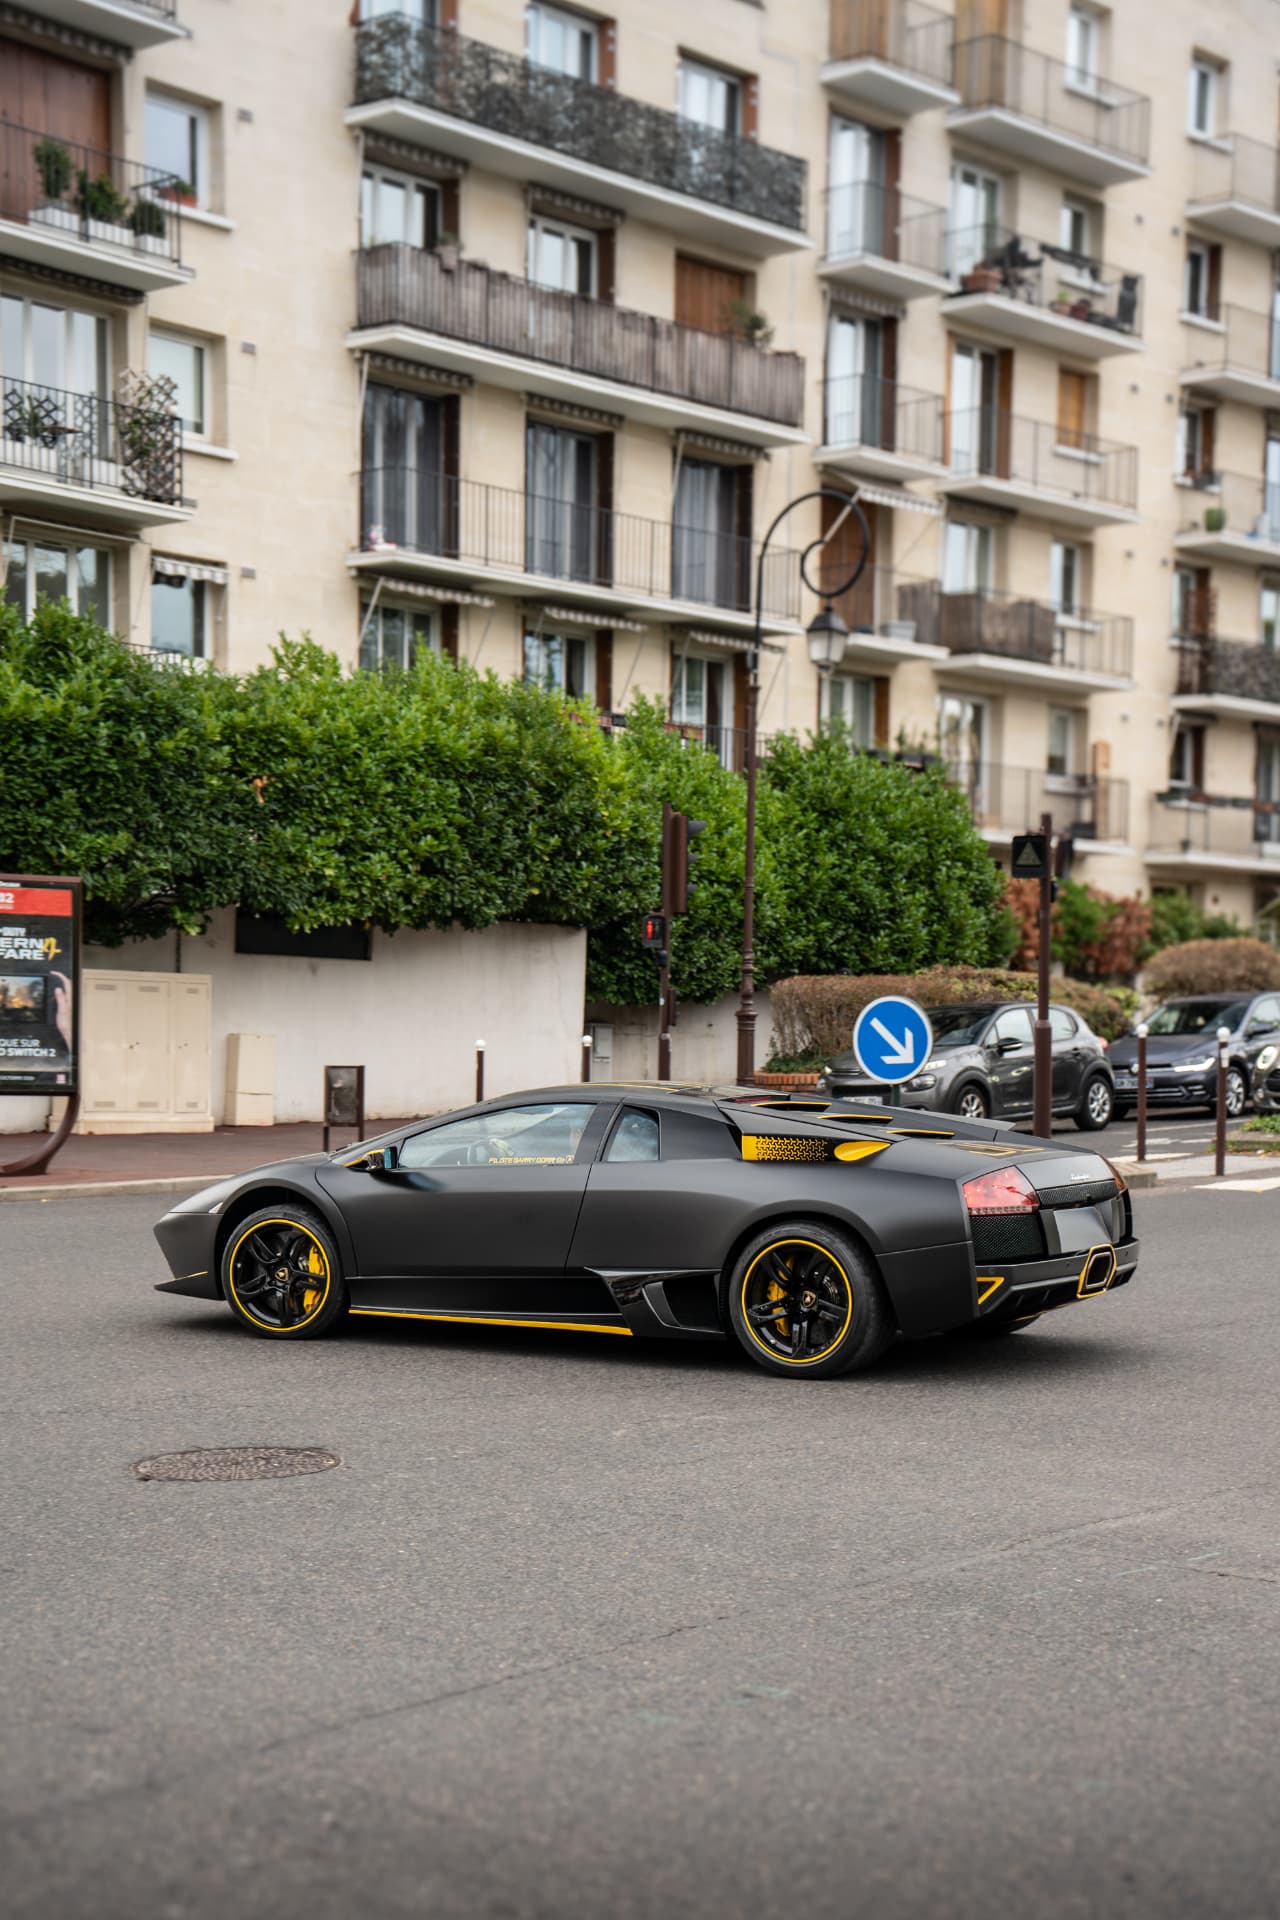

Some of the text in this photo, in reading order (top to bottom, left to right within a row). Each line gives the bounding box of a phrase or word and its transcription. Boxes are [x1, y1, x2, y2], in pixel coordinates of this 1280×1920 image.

[20, 1039, 41, 1048] SUR
[7, 1047, 48, 1057] SWITCH
[48, 1048, 57, 1058] 2
